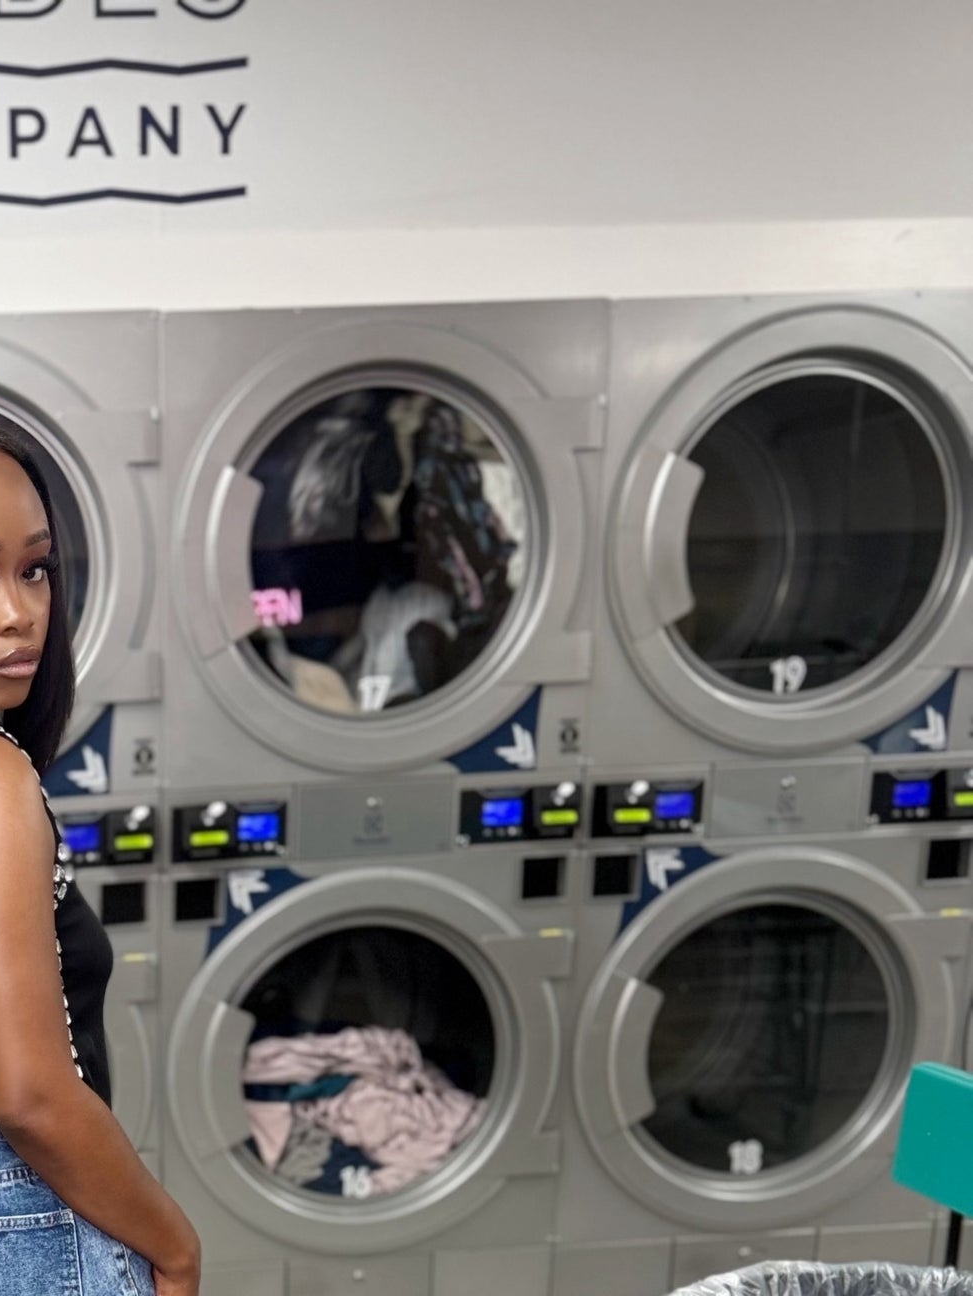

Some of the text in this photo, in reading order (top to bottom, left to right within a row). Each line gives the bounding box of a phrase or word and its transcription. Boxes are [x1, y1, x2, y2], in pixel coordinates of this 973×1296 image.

[358, 675, 393, 712] 17
[770, 655, 807, 695] 19
[340, 1165, 371, 1200] 16
